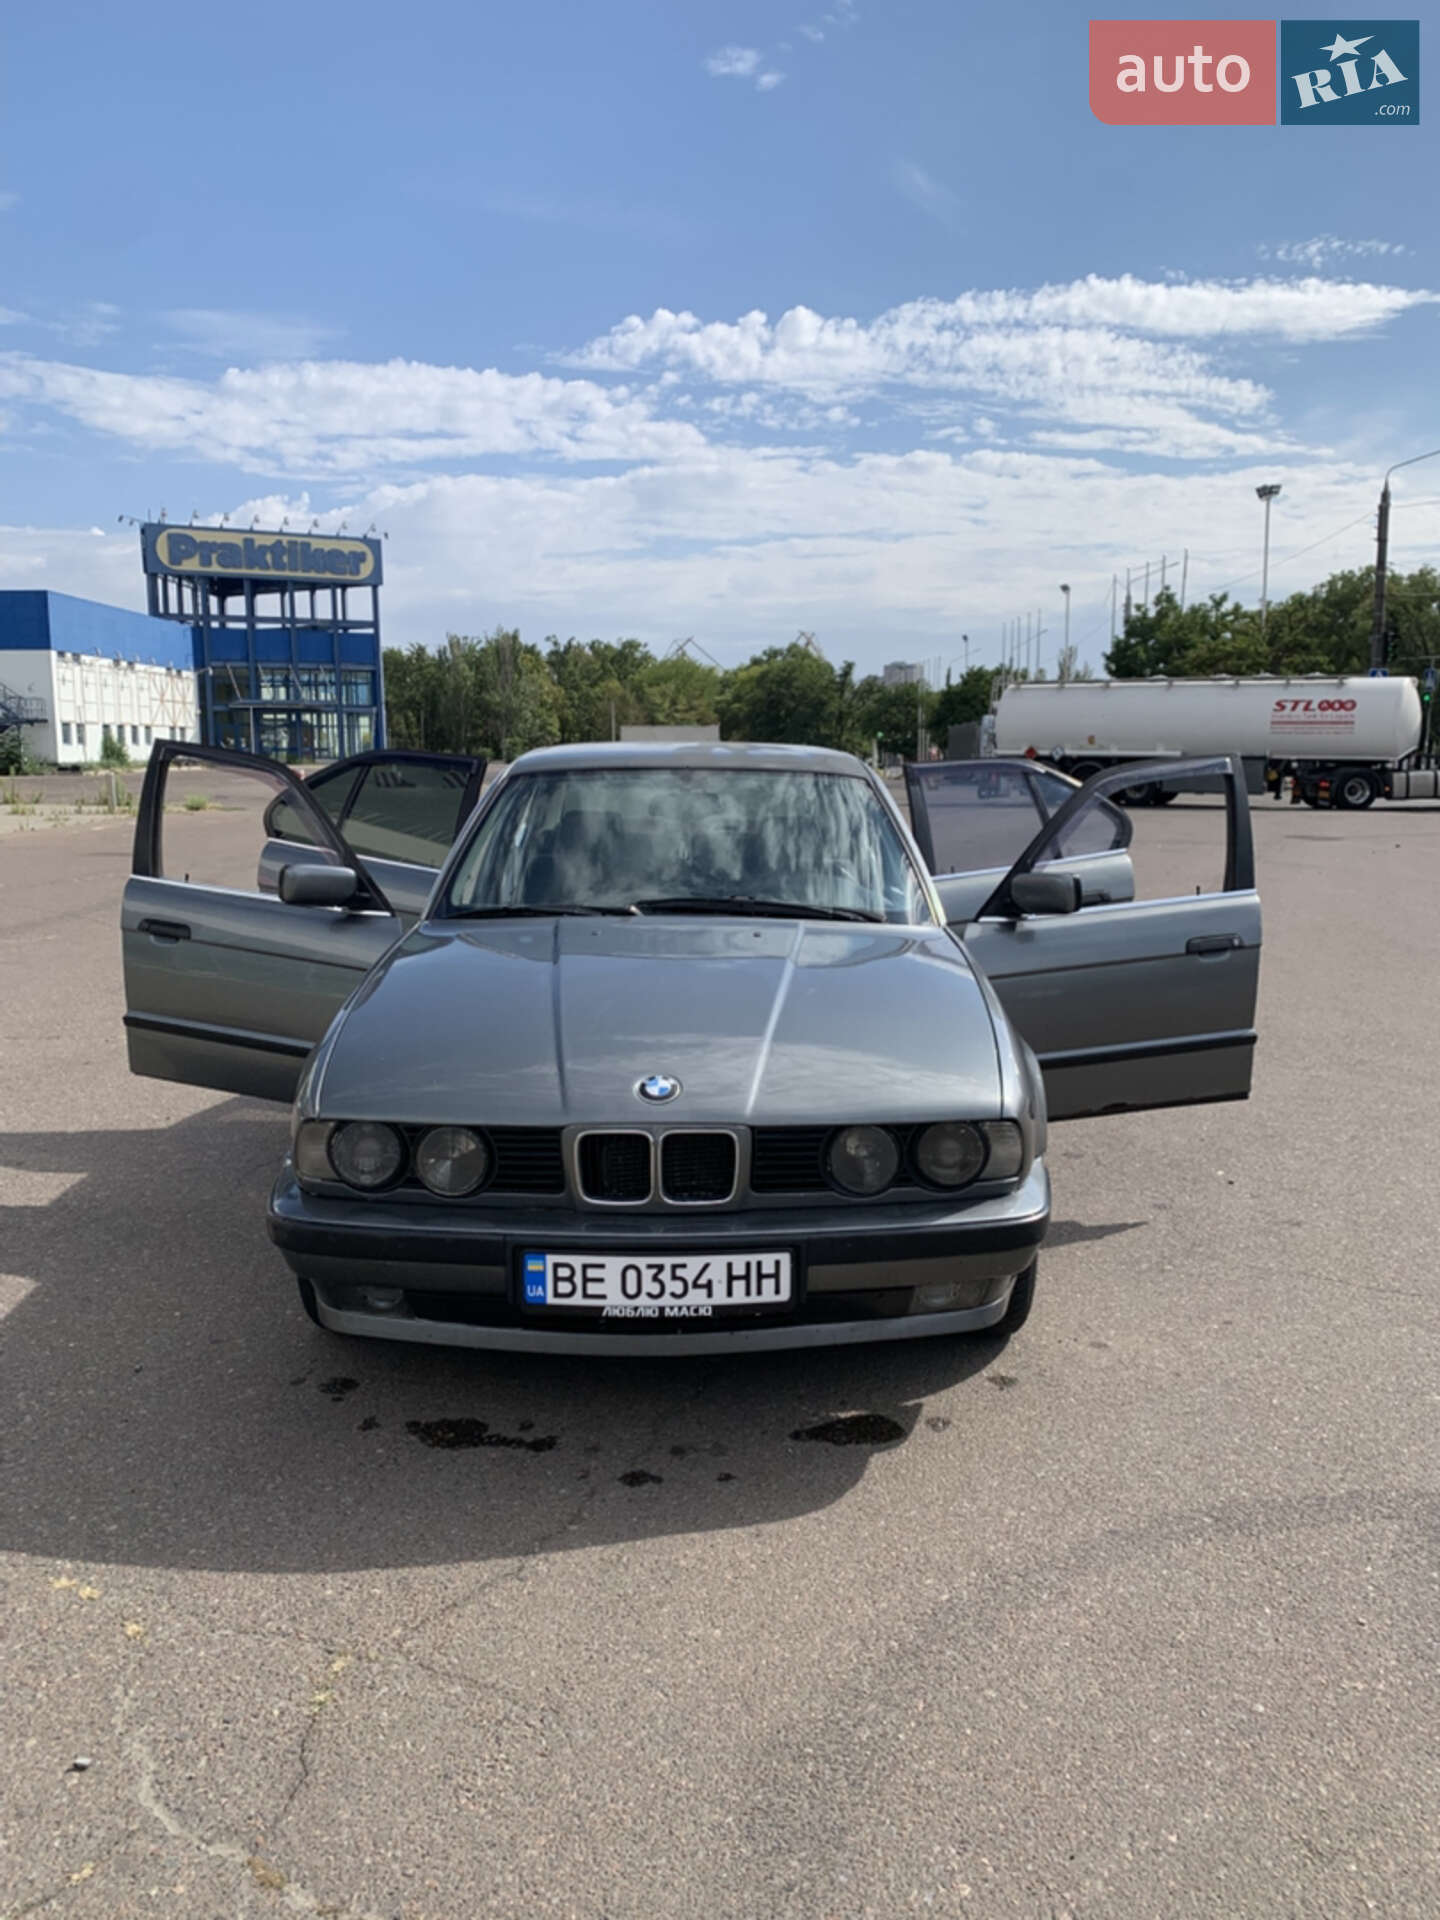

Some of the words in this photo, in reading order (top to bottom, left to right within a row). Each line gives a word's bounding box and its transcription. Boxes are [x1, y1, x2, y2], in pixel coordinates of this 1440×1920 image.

[166, 532, 366, 577] Praktiker
[527, 1285, 544, 1297] UA
[552, 1261, 608, 1299] BE
[620, 1261, 713, 1300] 0354
[726, 1259, 781, 1298] HH
[601, 1305, 660, 1318] ЛЮБЛЮ
